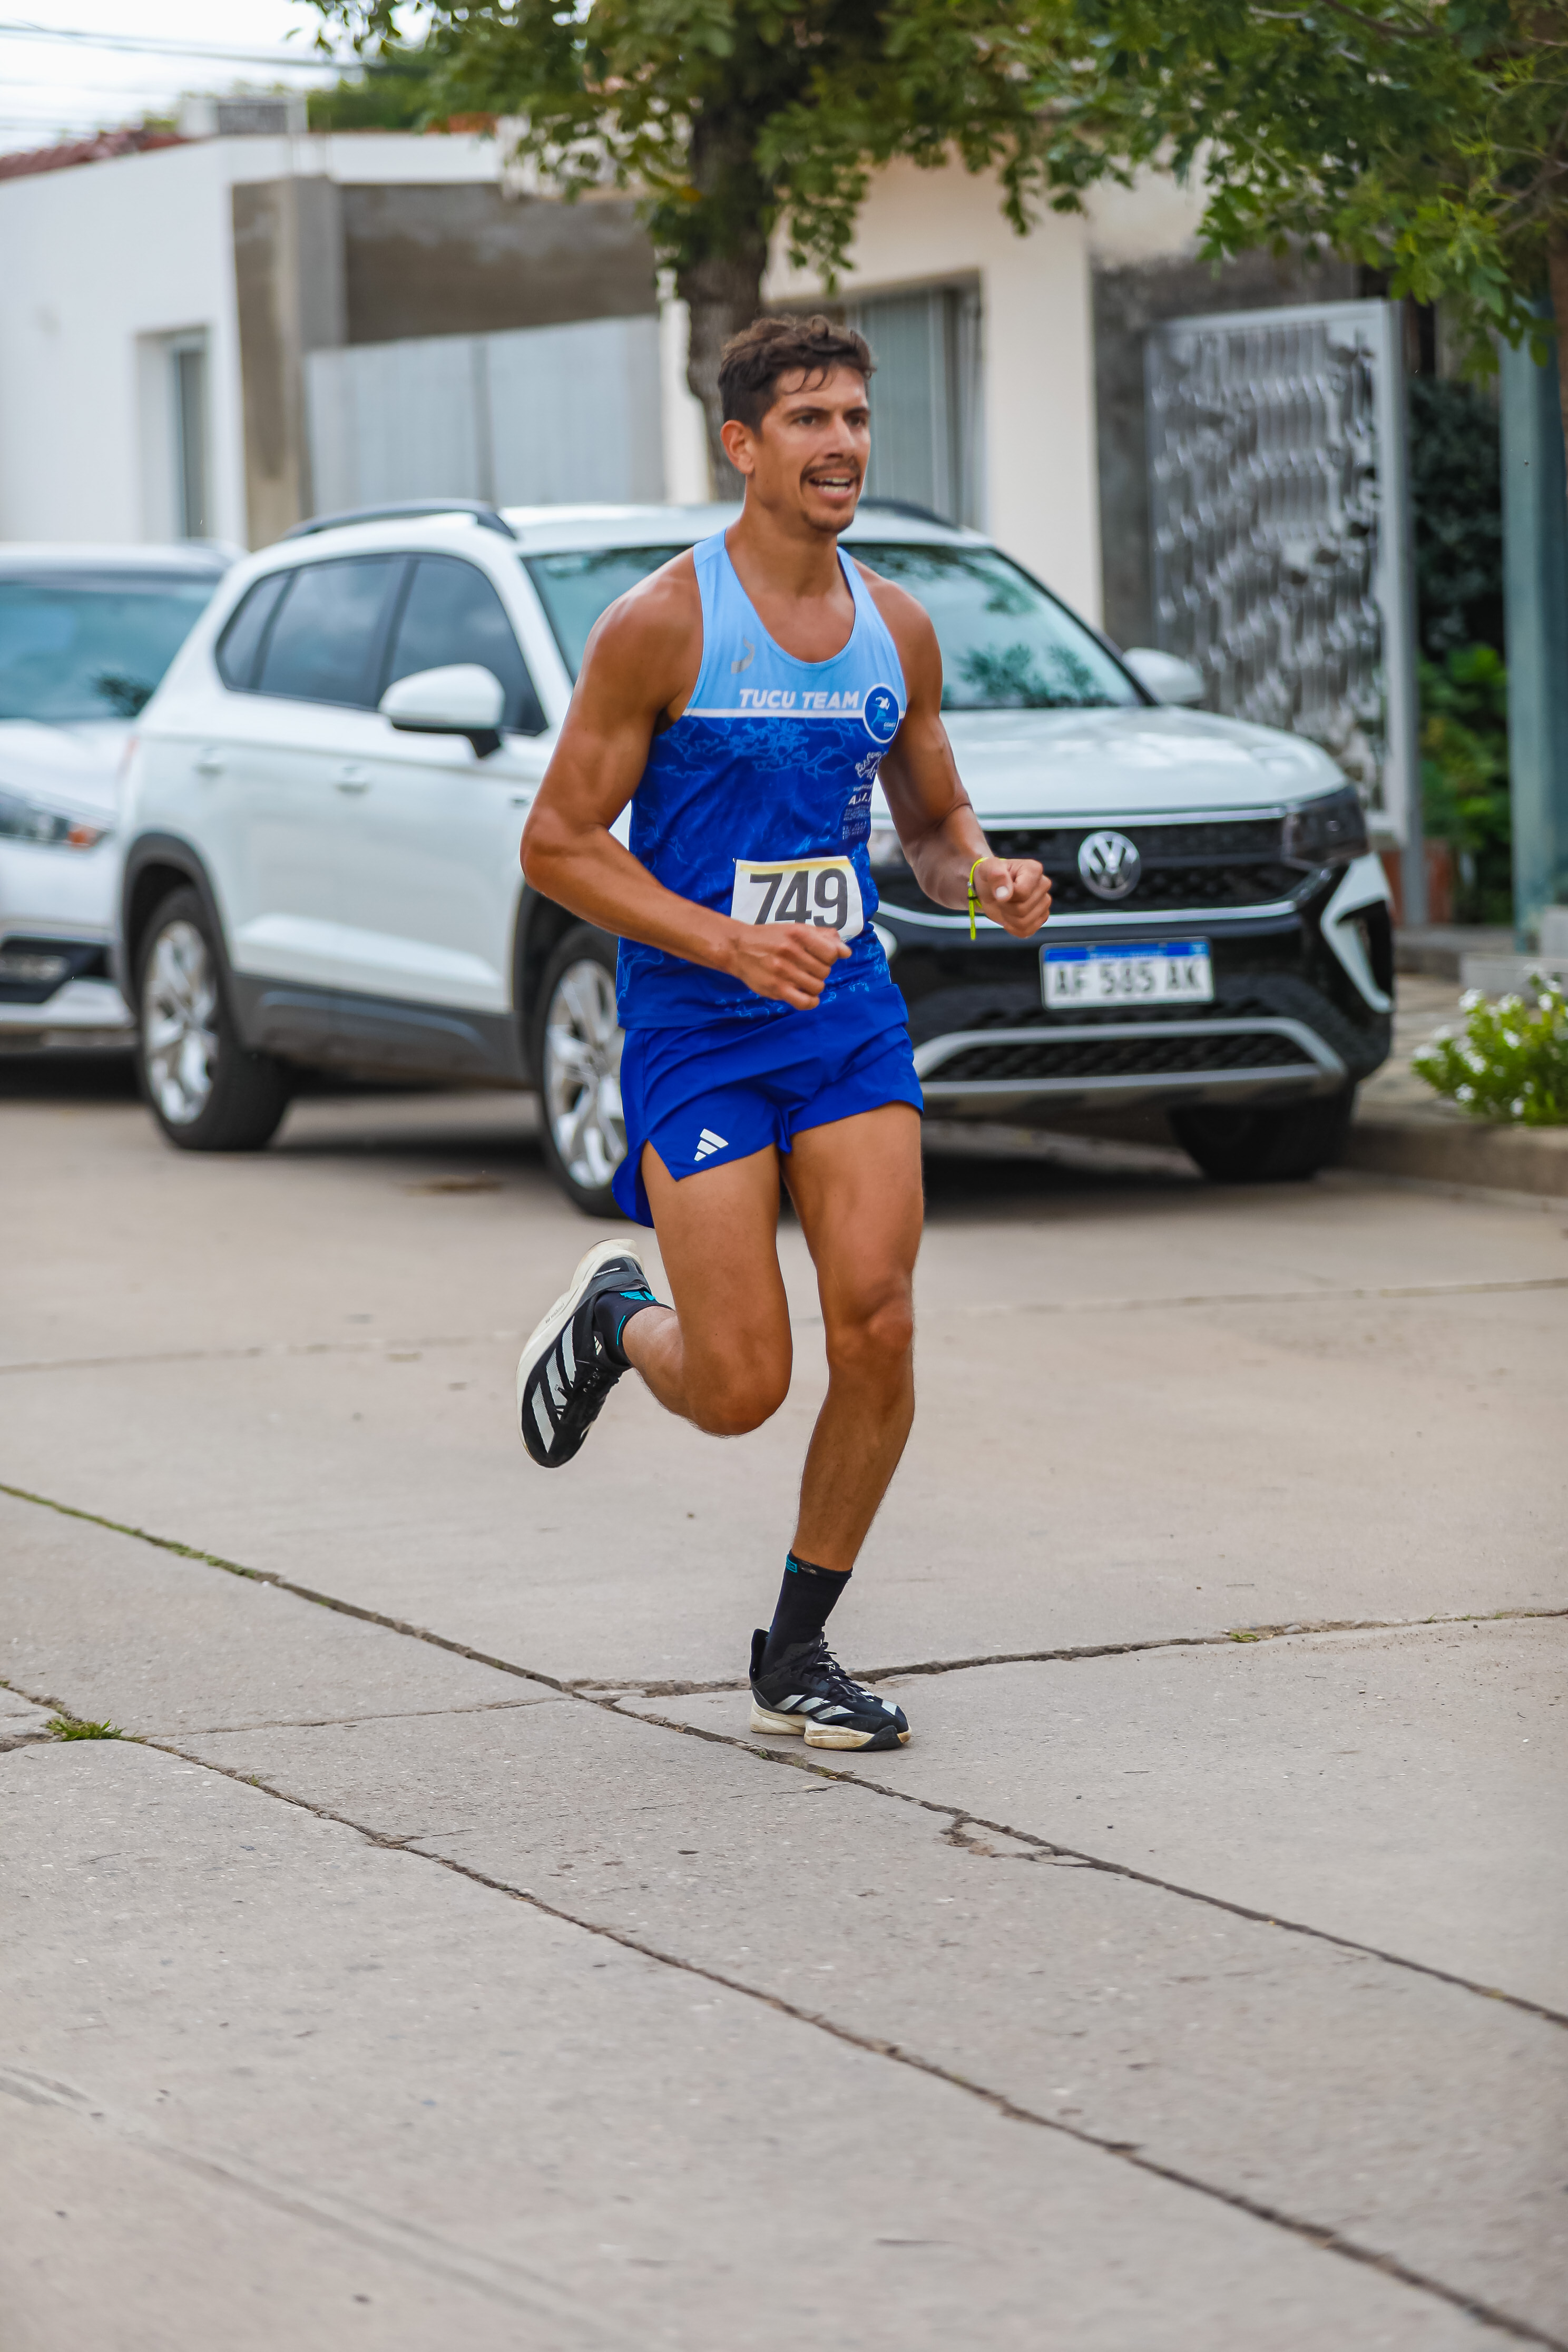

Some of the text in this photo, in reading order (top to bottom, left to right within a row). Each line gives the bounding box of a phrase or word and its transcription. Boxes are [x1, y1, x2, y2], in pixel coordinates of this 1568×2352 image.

[740, 688, 859, 709] TUCU TEAM
[749, 867, 848, 932] 749
[1055, 963, 1088, 995] AF
[1165, 958, 1202, 991] AK
